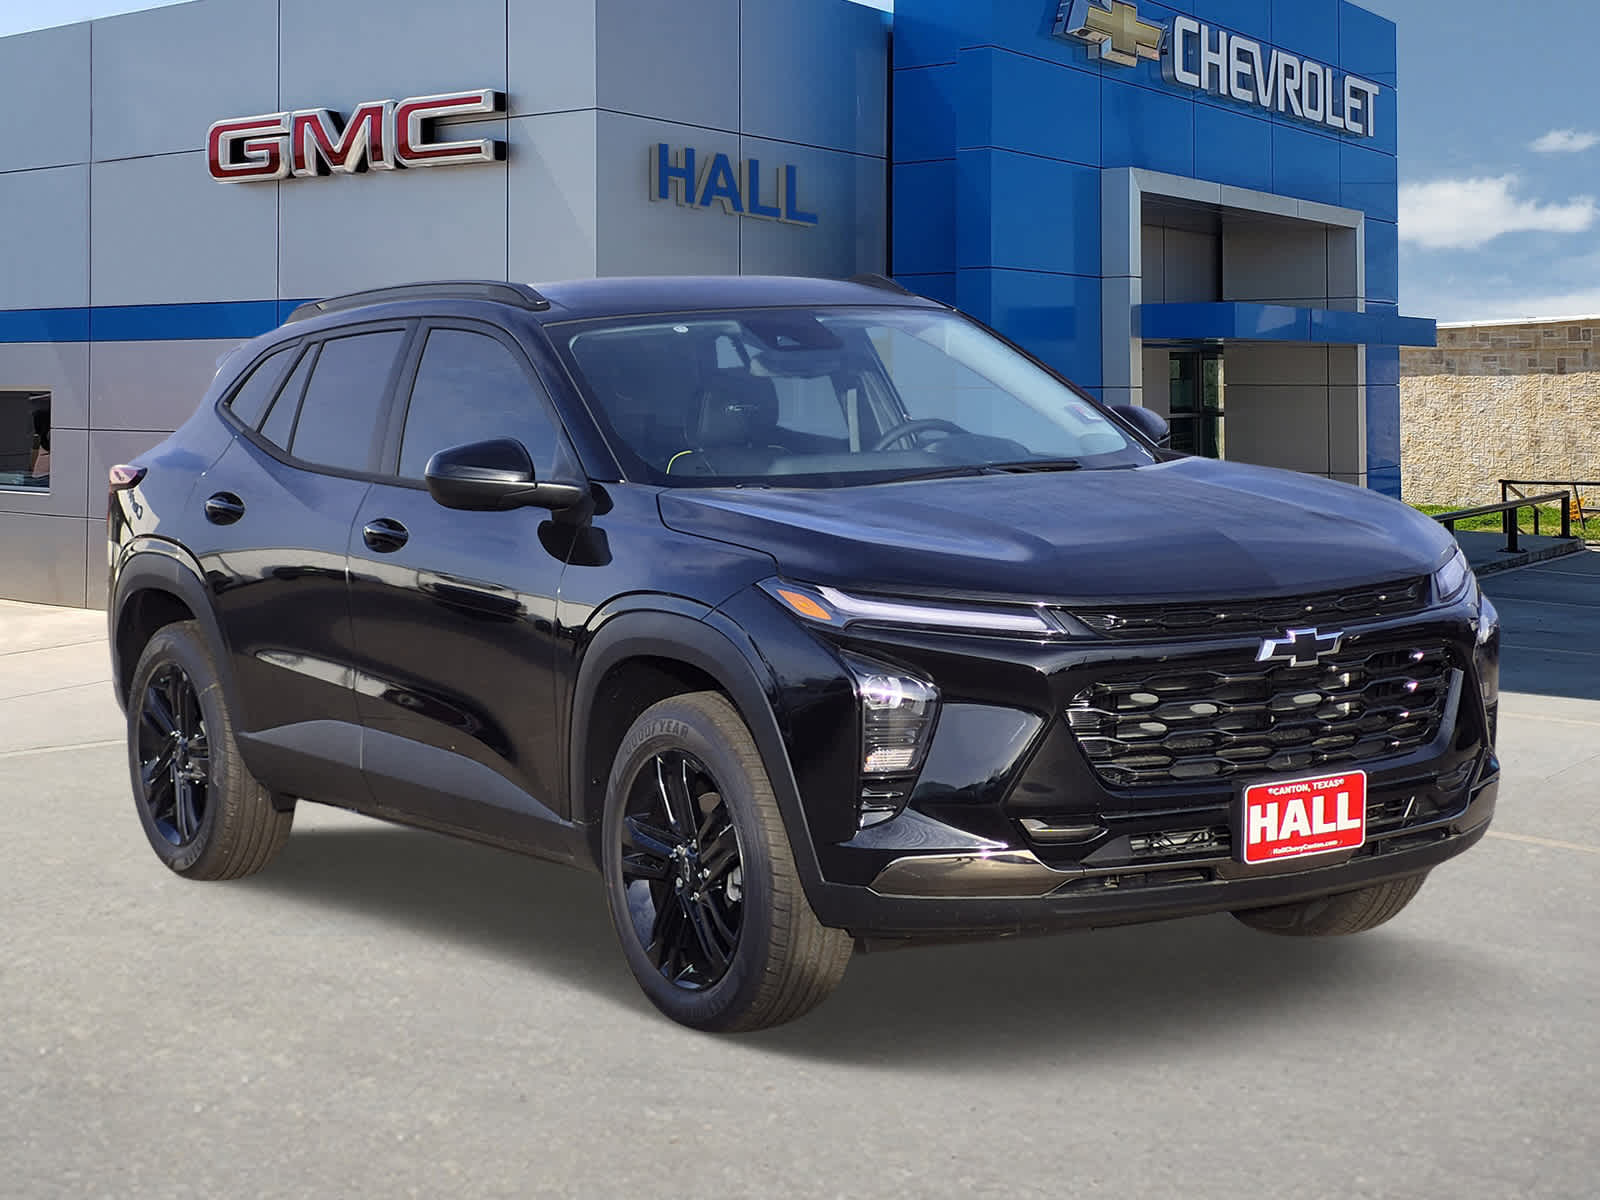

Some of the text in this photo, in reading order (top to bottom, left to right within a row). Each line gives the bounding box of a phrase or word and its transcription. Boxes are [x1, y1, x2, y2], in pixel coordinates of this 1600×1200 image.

[1173, 14, 1380, 138] CHEVROLET
[206, 88, 500, 184] GMC
[651, 142, 819, 226] HALL
[1250, 792, 1361, 844] HALL
[1273, 779, 1340, 796] CANTON, TEXAS
